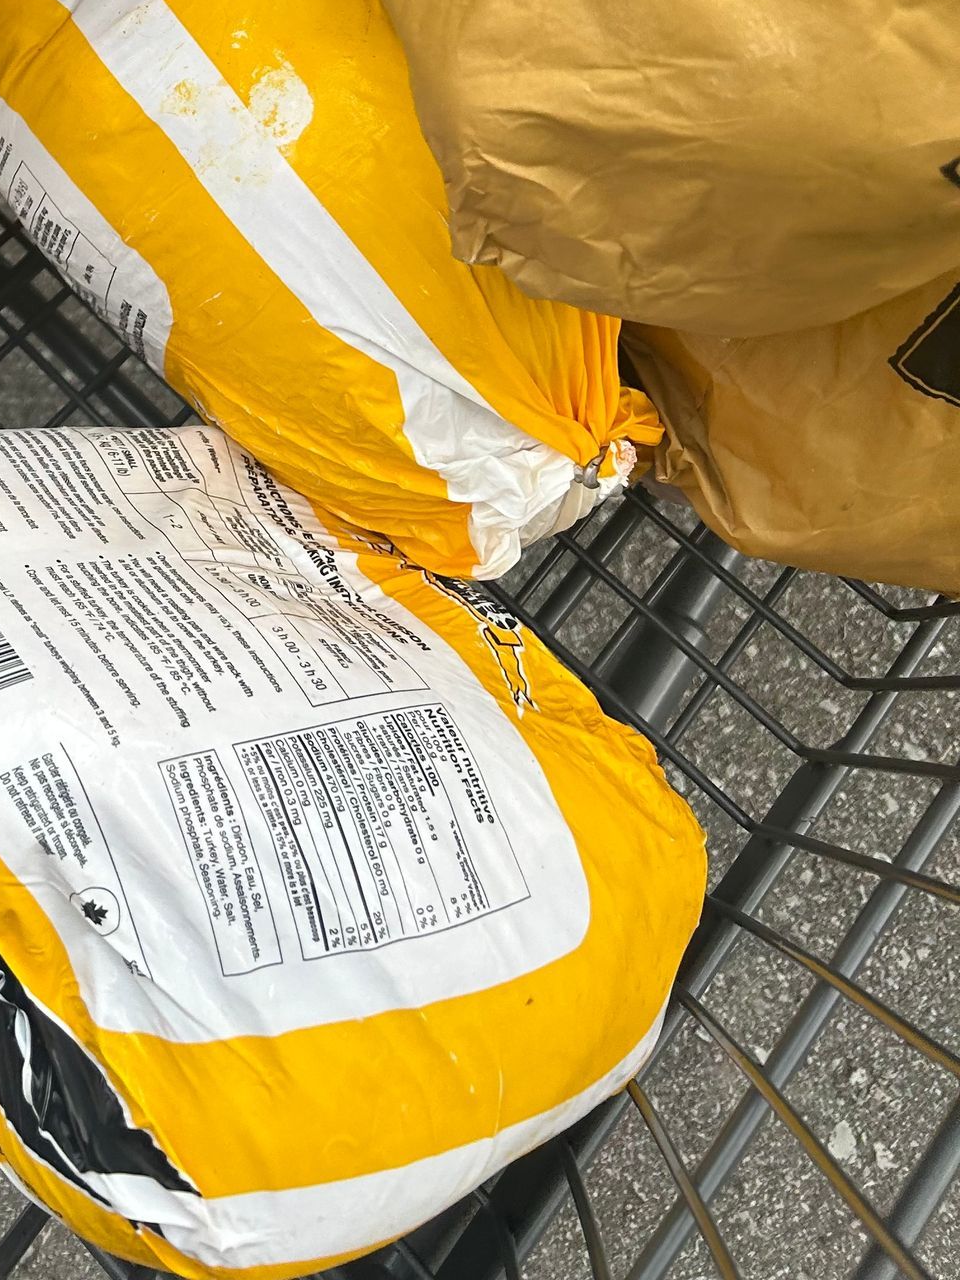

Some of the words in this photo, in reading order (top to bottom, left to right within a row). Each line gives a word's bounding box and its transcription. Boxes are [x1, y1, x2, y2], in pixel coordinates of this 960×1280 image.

[25, 568, 45, 586] Cover
[38, 585, 54, 598] and
[56, 605, 73, 619] rest
[67, 617, 81, 628] 15
[75, 627, 101, 654] minutes
[97, 654, 119, 677] before
[115, 678, 141, 708] serving.
[41, 753, 61, 778] Garder
[67, 807, 80, 819] ou
[275, 739, 299, 778] Calcium
[288, 735, 317, 787] Potassium
[295, 779, 305, 789] 0
[303, 732, 328, 772] Sodium
[325, 773, 340, 794] 470
[333, 794, 346, 813] mg
[396, 714, 426, 762] Calories
[424, 764, 440, 788] 100
[424, 709, 462, 773] Nutrition
[461, 778, 484, 823] Facts
[436, 705, 466, 753] Valeur
[462, 757, 494, 824] nutritive
[5, 783, 22, 800] not
[13, 797, 36, 828] refreeze
[294, 789, 312, 810] mg
[313, 787, 329, 810] 225
[317, 810, 335, 832] mg
[166, 764, 186, 804] Sodium
[179, 806, 204, 861] phosphate,
[199, 863, 221, 920] Seasoning.
[178, 760, 207, 827] Ingredients:
[202, 827, 220, 868] Turkey,
[214, 867, 230, 902] Water,
[222, 901, 237, 927] Salt,
[193, 757, 219, 812] Phosphate
[213, 814, 225, 829] de
[219, 830, 237, 871] sodium,
[232, 873, 260, 962] Assaisonnements.
[204, 755, 234, 817] Ingrédients
[231, 825, 248, 865] Dindon,
[243, 866, 257, 892] Eau,
[250, 892, 265, 913] Sel,
